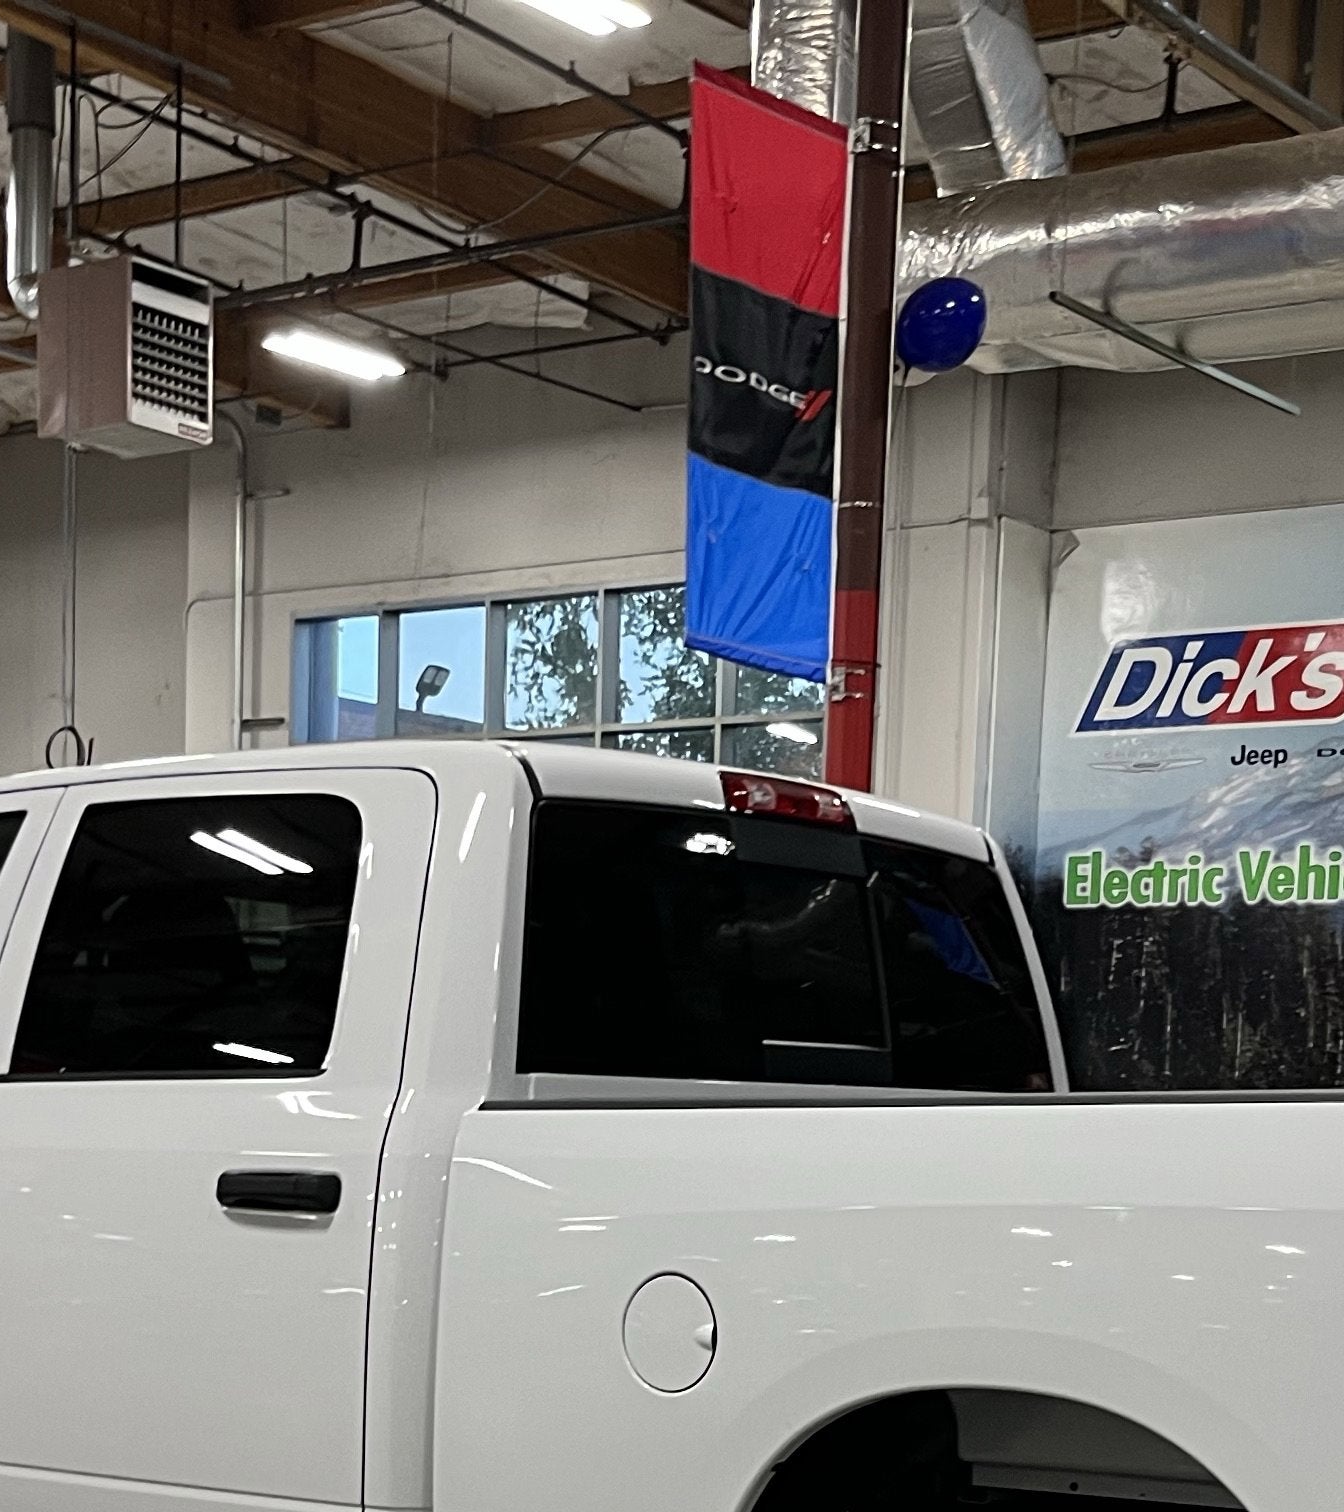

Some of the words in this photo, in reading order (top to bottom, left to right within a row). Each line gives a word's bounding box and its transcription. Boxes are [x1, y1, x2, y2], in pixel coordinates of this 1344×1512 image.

[694, 355, 807, 410] DODGE
[1230, 744, 1288, 768] Jeep
[1066, 851, 1224, 905] Electric
